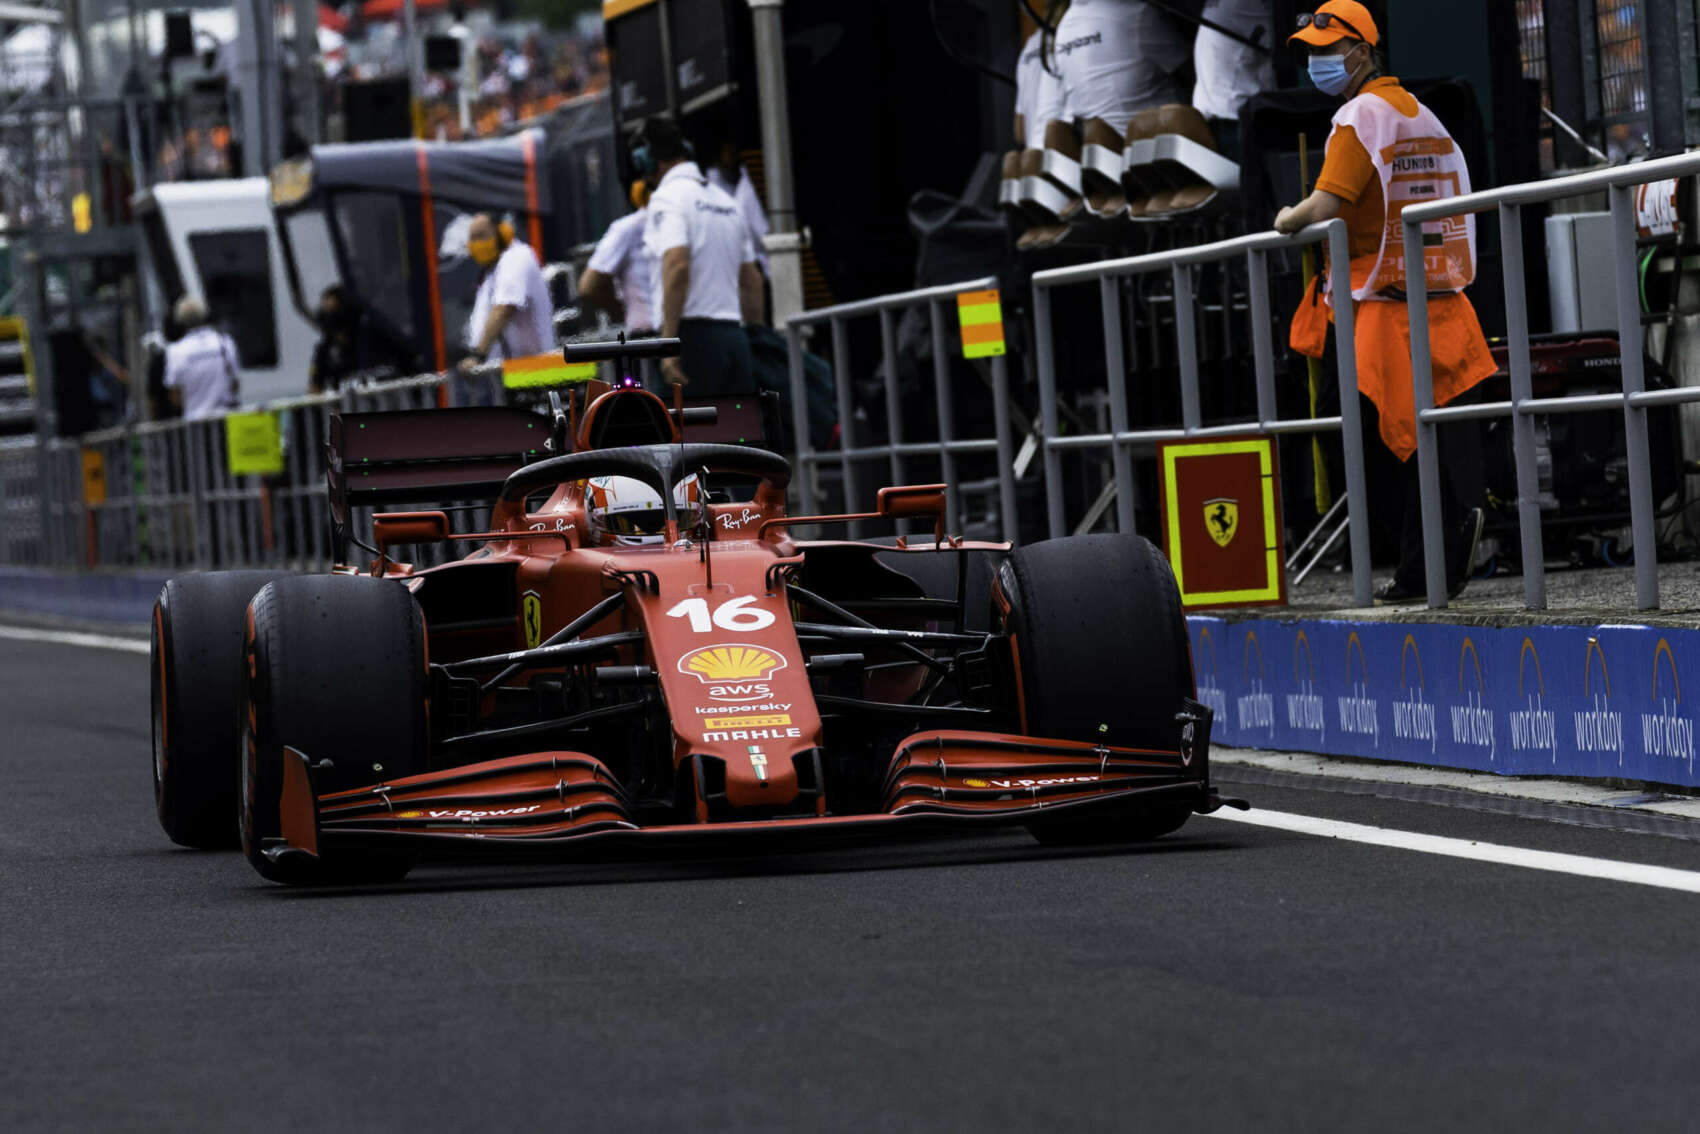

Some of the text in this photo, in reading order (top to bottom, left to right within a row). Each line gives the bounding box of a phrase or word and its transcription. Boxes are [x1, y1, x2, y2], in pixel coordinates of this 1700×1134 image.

[1583, 356, 1622, 367] HOND
[716, 509, 760, 529] Ray-Ban
[666, 594, 776, 632] 16
[709, 683, 771, 697] aws
[695, 703, 792, 714] kaspersky
[1338, 682, 1379, 748] workday
[1393, 687, 1436, 754] workday
[702, 727, 801, 742] MAHLE
[1451, 691, 1495, 761] workday
[1510, 693, 1556, 764] workday
[1575, 693, 1622, 766] workday
[1642, 697, 1693, 776] workday
[991, 776, 1099, 788] V-Power
[429, 805, 541, 818] V-Power
